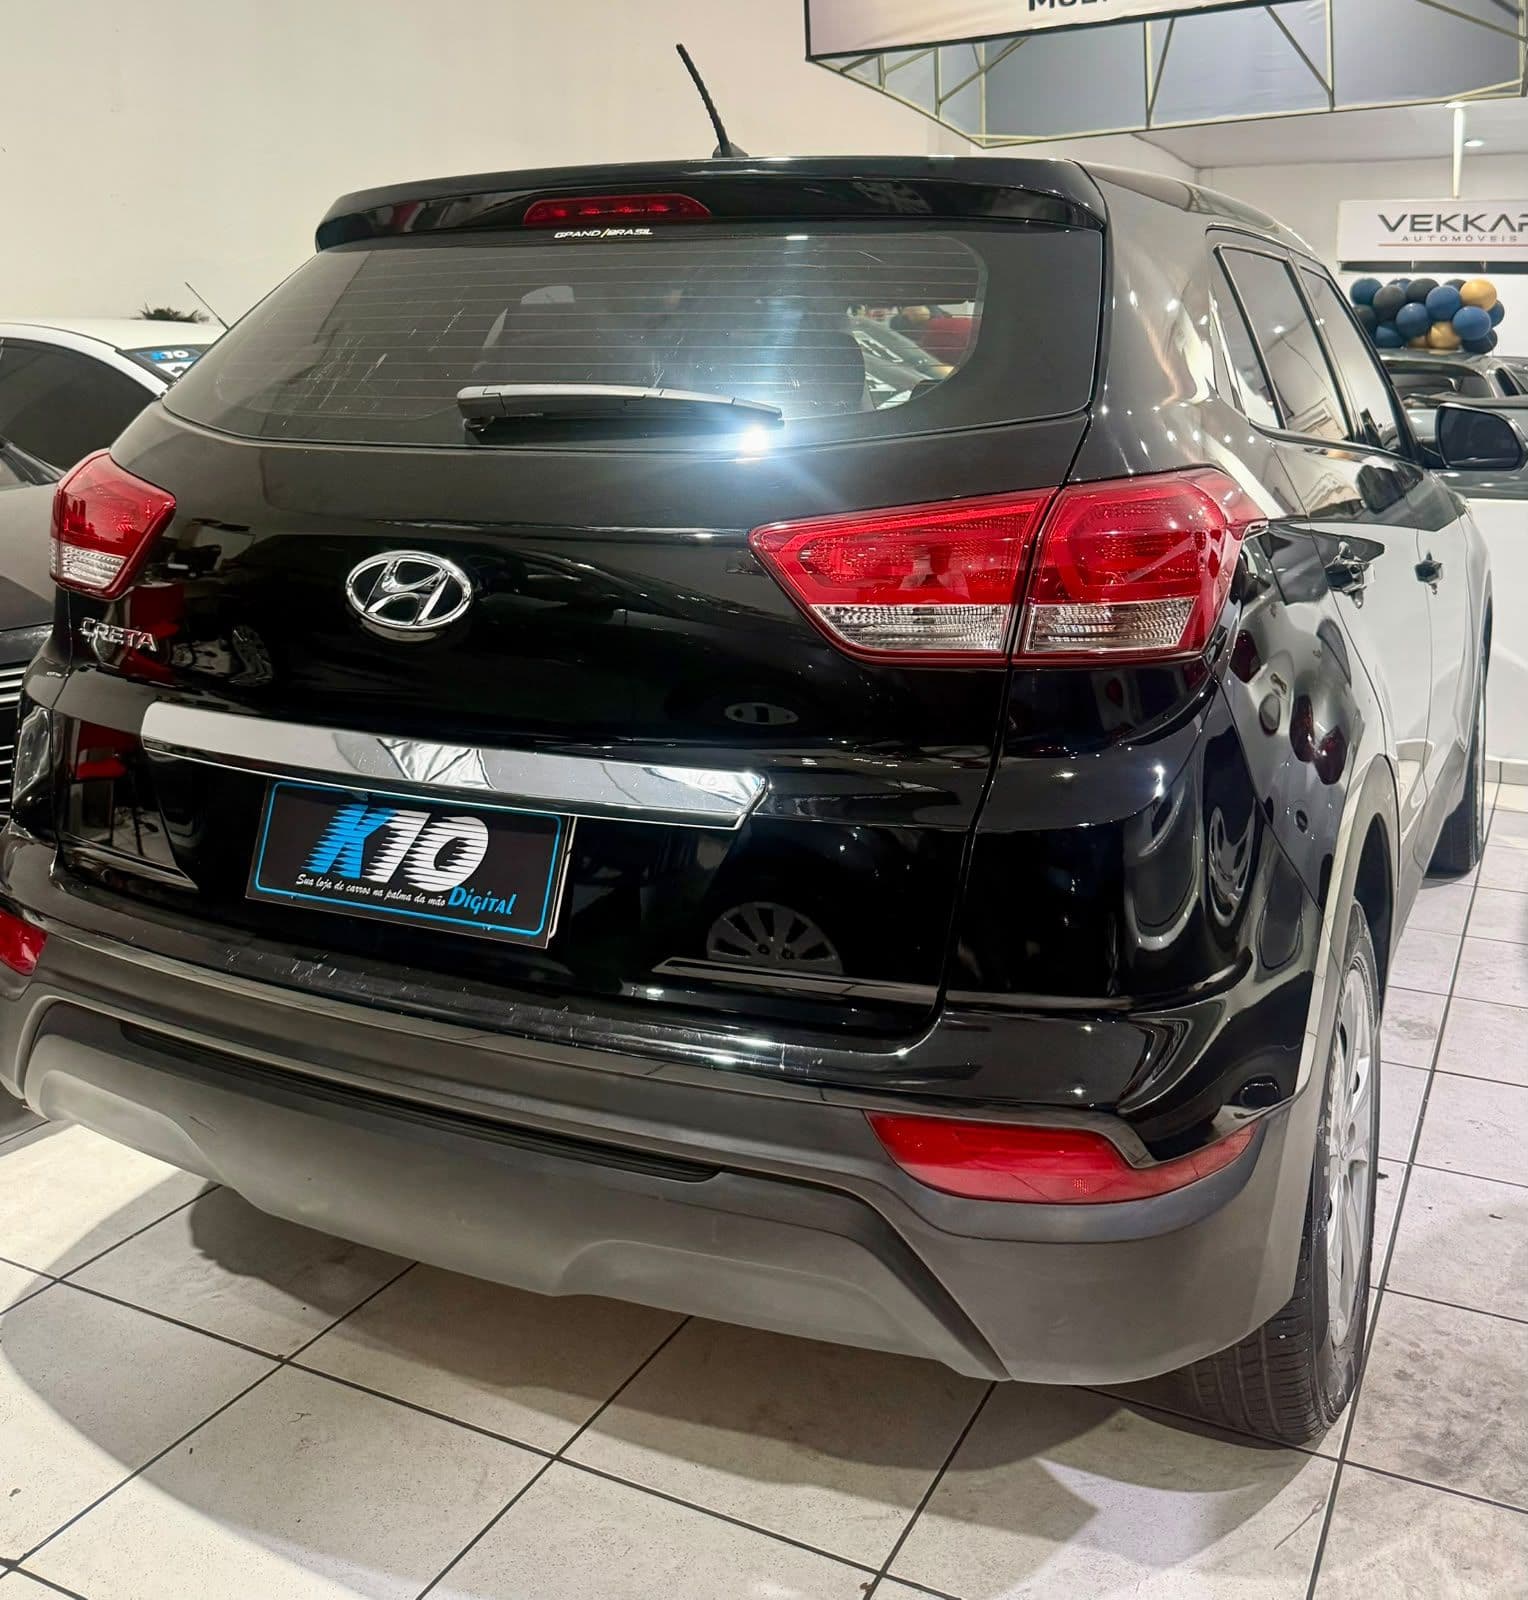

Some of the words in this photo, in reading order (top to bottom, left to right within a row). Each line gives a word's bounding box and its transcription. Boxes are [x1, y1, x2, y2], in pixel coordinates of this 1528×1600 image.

[1402, 233, 1518, 242] AUTOMÓVEIS
[80, 616, 157, 652] CRETA
[301, 803, 489, 892] K10
[296, 873, 314, 886] Sua
[316, 876, 333, 891] loja
[334, 880, 345, 891] de
[346, 884, 371, 895] carros
[372, 889, 384, 897] na
[384, 888, 412, 901] palma
[414, 892, 426, 904] da
[427, 895, 446, 907] mão
